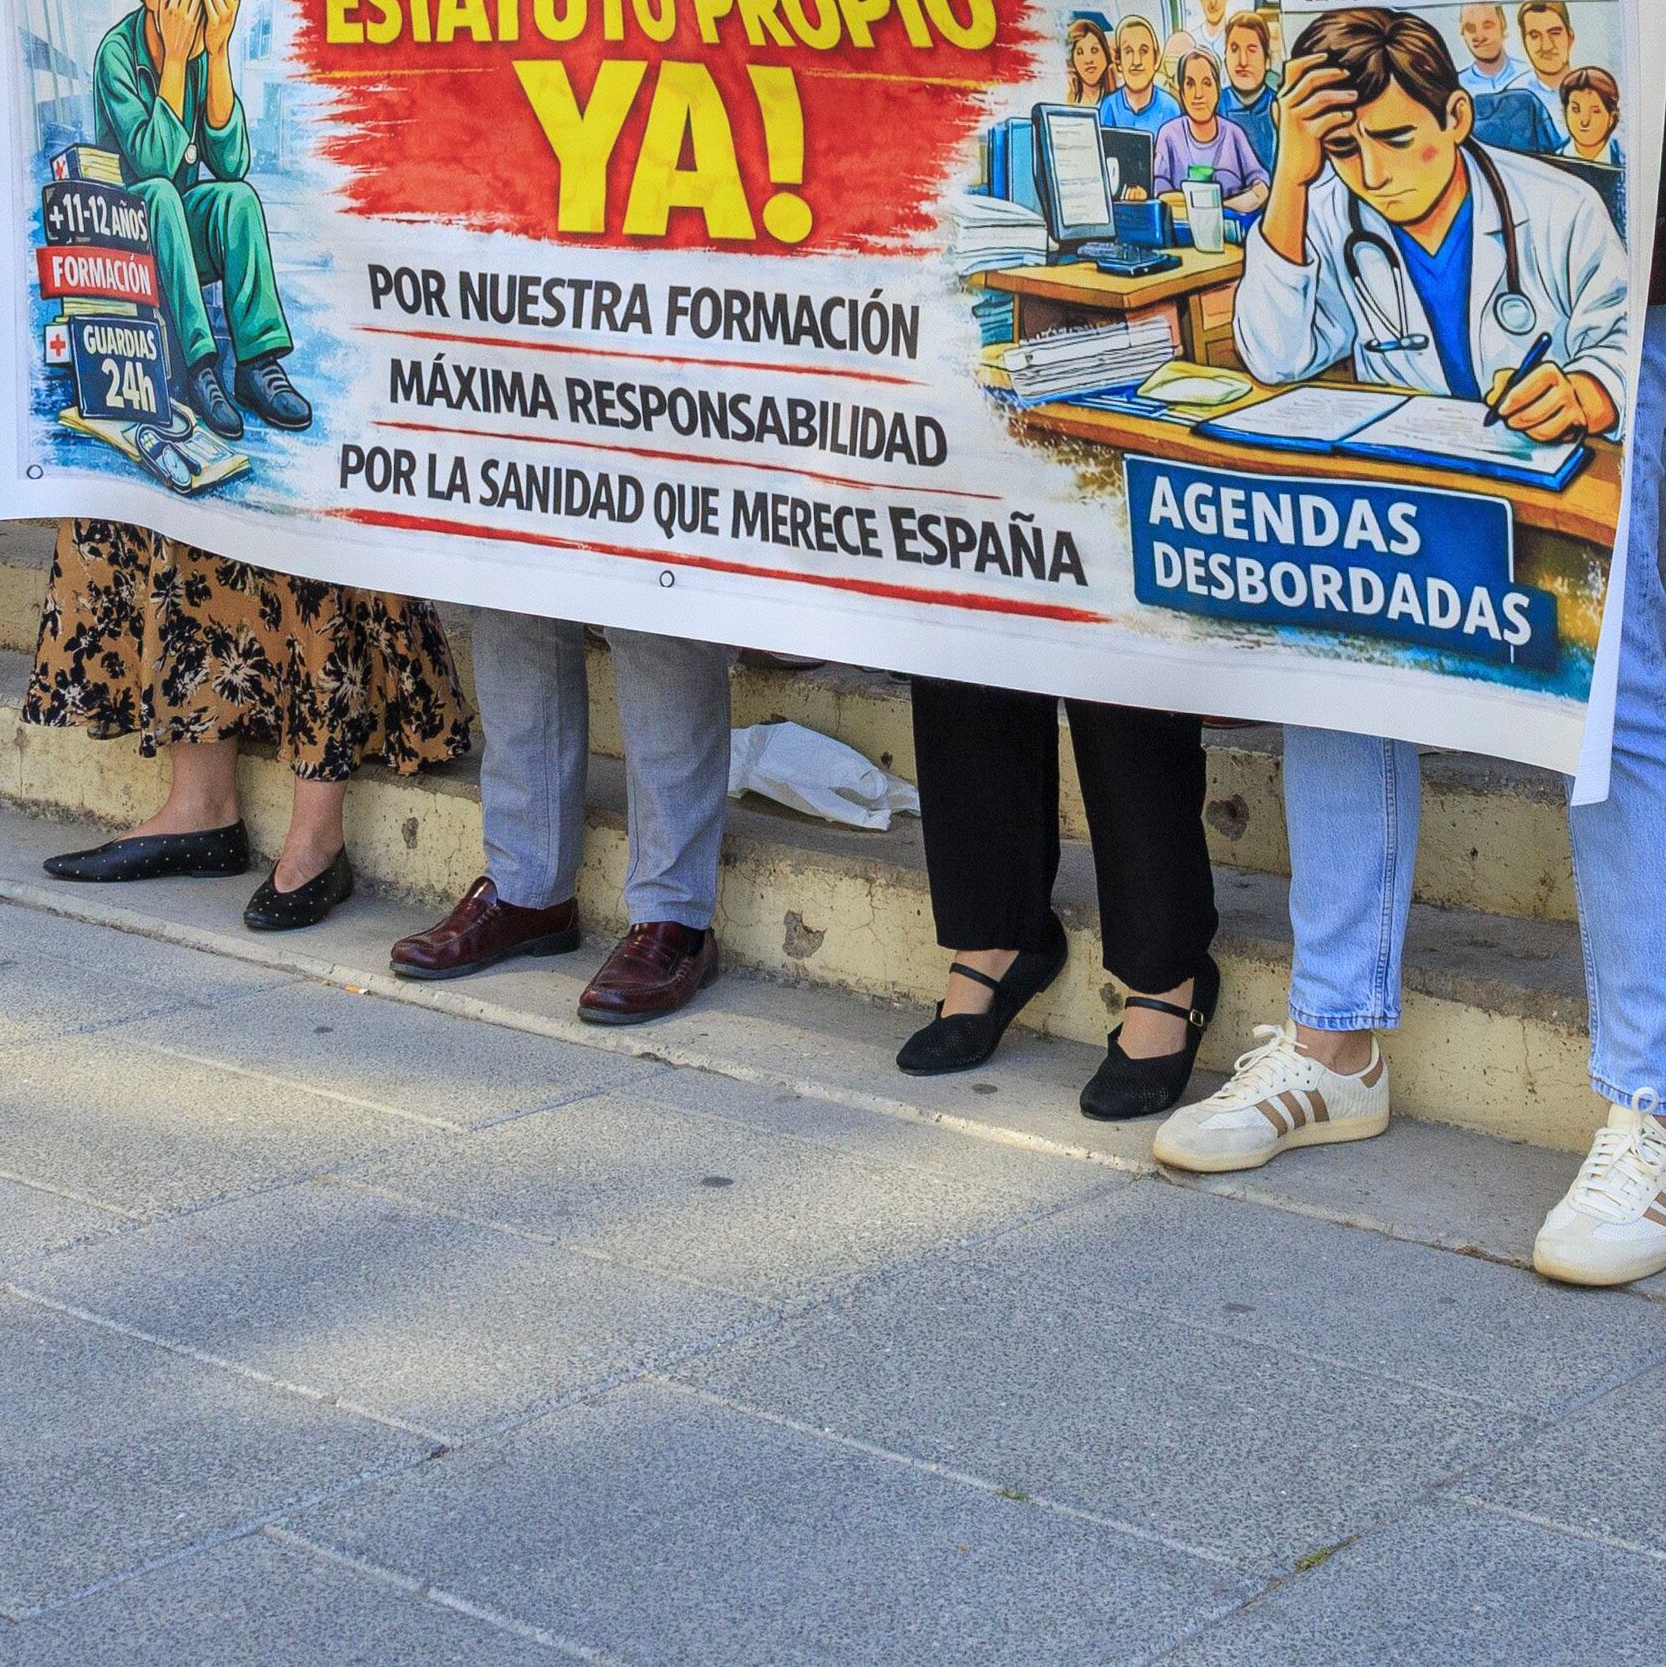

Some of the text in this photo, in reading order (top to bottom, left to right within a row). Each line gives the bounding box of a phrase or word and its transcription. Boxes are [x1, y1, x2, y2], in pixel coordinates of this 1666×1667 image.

[513, 60, 814, 243] YA!
[49, 193, 148, 241] +11-12 AÑOS
[52, 254, 152, 295] FORMACIÓN
[369, 264, 920, 359] POR NUESTRA FORMACIÓN
[83, 325, 158, 361] GUARDIAS
[101, 358, 157, 413] 24h
[388, 351, 949, 469] MÁXIMA RESPONSABILIDAD
[339, 444, 1089, 589] POR LA SANIDAD QUE MERECE ESPAÑA
[1149, 475, 1419, 556] AGENDAS
[1153, 540, 1533, 647] DESBORDADAS
